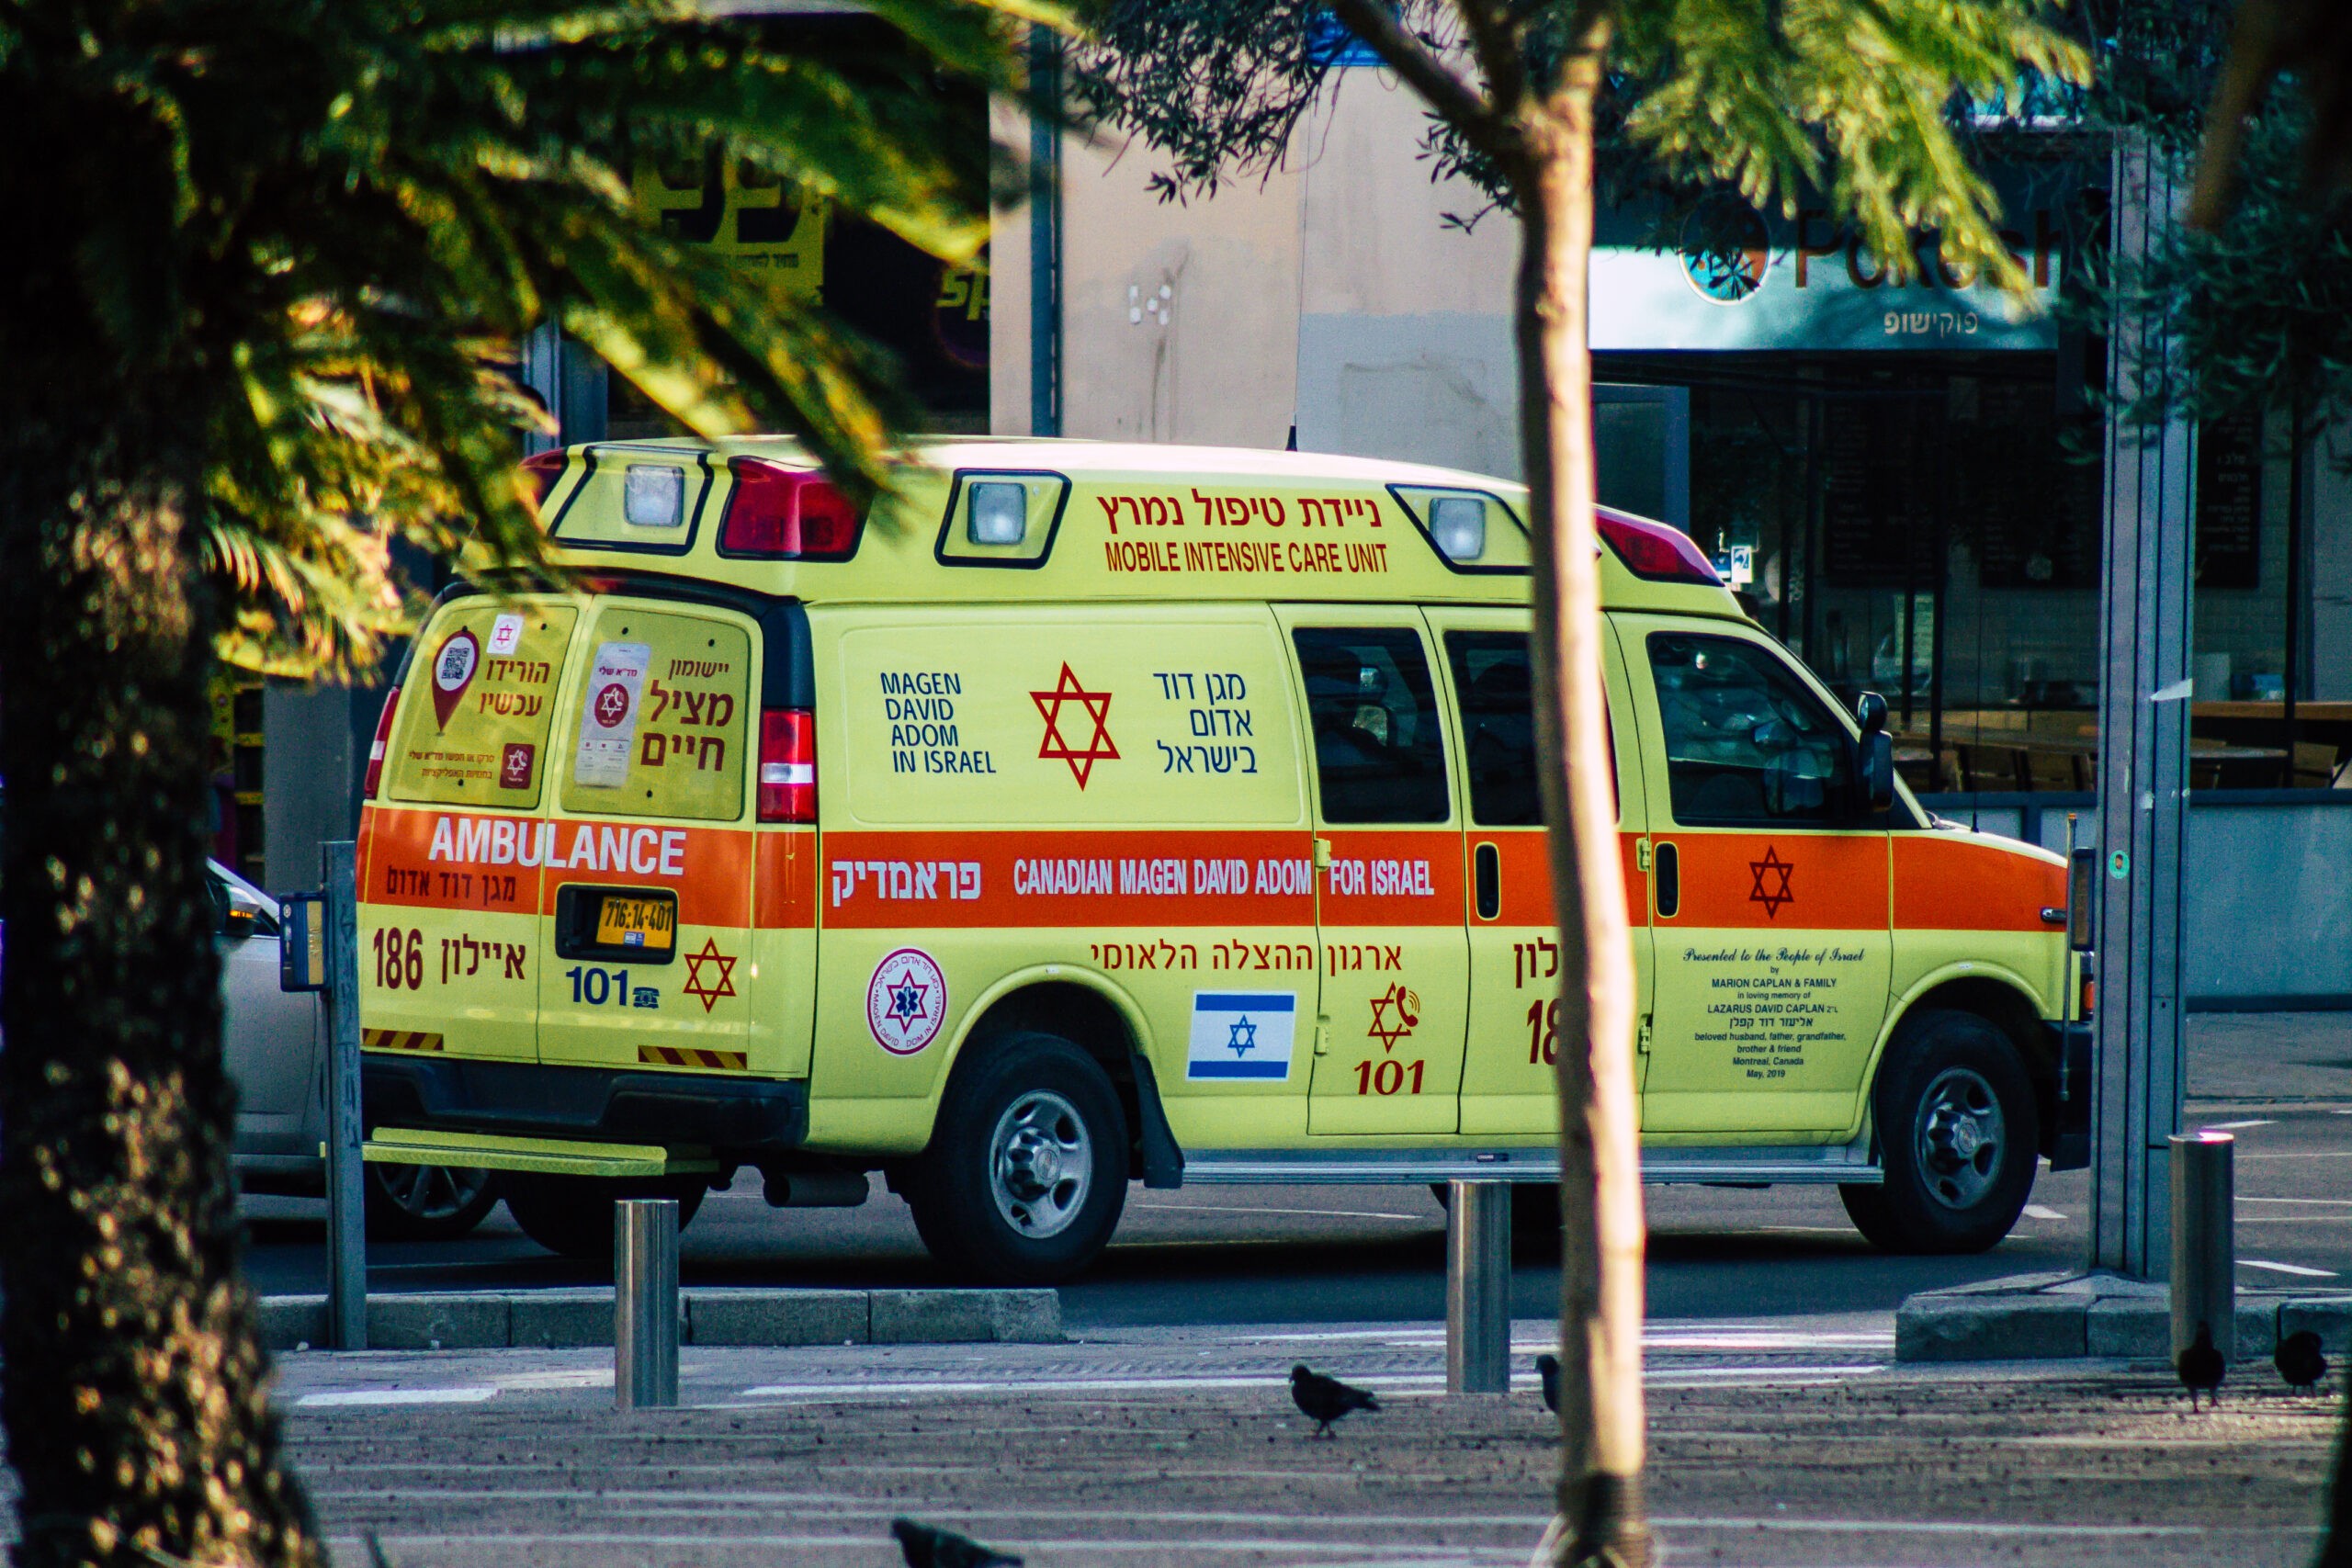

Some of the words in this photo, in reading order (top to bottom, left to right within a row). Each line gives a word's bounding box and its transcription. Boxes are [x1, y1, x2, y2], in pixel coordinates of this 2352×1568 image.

[1884, 311, 1978, 337] פוקישופ
[1096, 496, 1184, 534] נמרץ
[1192, 488, 1285, 526] טיפול
[1297, 498, 1382, 527] ניידת
[1104, 541, 1181, 572] MOBILE
[1184, 542, 1284, 572] INTENSIVE
[1288, 542, 1342, 572] CARE
[1344, 543, 1387, 573] UNIT
[486, 660, 550, 683] הורידו
[599, 666, 614, 676] שלי
[668, 659, 729, 680] יישומון
[879, 671, 962, 695] MAGEN
[1153, 671, 1195, 700] דוד
[1209, 672, 1247, 705] מגן
[480, 693, 542, 716] עכשיו
[650, 680, 733, 727] מציל
[885, 698, 954, 721] DAVID
[891, 724, 959, 747] ADOM
[1190, 708, 1253, 737] אדום
[640, 732, 725, 772] חיים
[892, 750, 919, 773] IN
[923, 750, 996, 774] ISRAEL
[1156, 739, 1258, 774] בישראל
[428, 816, 686, 876] AMBULANCE
[387, 865, 430, 897] אדום
[439, 872, 473, 898] דוד
[481, 874, 515, 906] מגן
[831, 860, 981, 907] פראמדיק
[1013, 859, 1113, 895] CANADIAN
[1119, 859, 1187, 895] MAGEN
[1193, 859, 1249, 896] DAVID
[1254, 859, 1311, 896] ADOM
[1329, 859, 1365, 896] FOR
[1372, 859, 1434, 896] ISRAEL
[372, 926, 423, 990] 186
[441, 933, 526, 985] איילון
[1091, 938, 1197, 970] הלאומי
[1212, 938, 1313, 971] ההצלה
[1327, 943, 1402, 976] ארגון
[1682, 948, 1737, 962] Presented
[1740, 949, 1751, 962] to
[1755, 949, 1771, 962] the
[1776, 947, 1812, 965] People
[1815, 948, 1826, 965] of
[1829, 948, 1865, 962] Israel
[1712, 978, 1749, 988] MARION
[1753, 978, 1792, 988] CAPLAN
[1794, 978, 1801, 987] &
[1804, 978, 1837, 987] FAMILY
[1770, 965, 1780, 975] by
[565, 966, 628, 1007] 101
[1737, 991, 1745, 999] in
[1747, 991, 1770, 1001] loving
[1771, 992, 1801, 1000] memory
[1803, 991, 1811, 999] of
[873, 993, 882, 1028] MAGEN
[880, 1028, 899, 1046] DAVID
[925, 1027, 933, 1036] IN
[931, 995, 941, 1026] ISRAEL
[1707, 1004, 1752, 1013] LAZARUS
[1755, 1004, 1783, 1013] DAVID
[1786, 1004, 1825, 1013] CAPLAN
[1730, 1017, 1754, 1029] קפלן
[1758, 1017, 1774, 1027] דוד
[1527, 998, 1560, 1066] 18
[1694, 1032, 1727, 1041] beloved
[1729, 1032, 1767, 1041] husband,
[1736, 1044, 1766, 1053] brother
[1769, 1044, 1775, 1053] &
[1777, 1044, 1802, 1053] friend
[1773, 1057, 1804, 1066] Canada
[1353, 1059, 1425, 1095] 101
